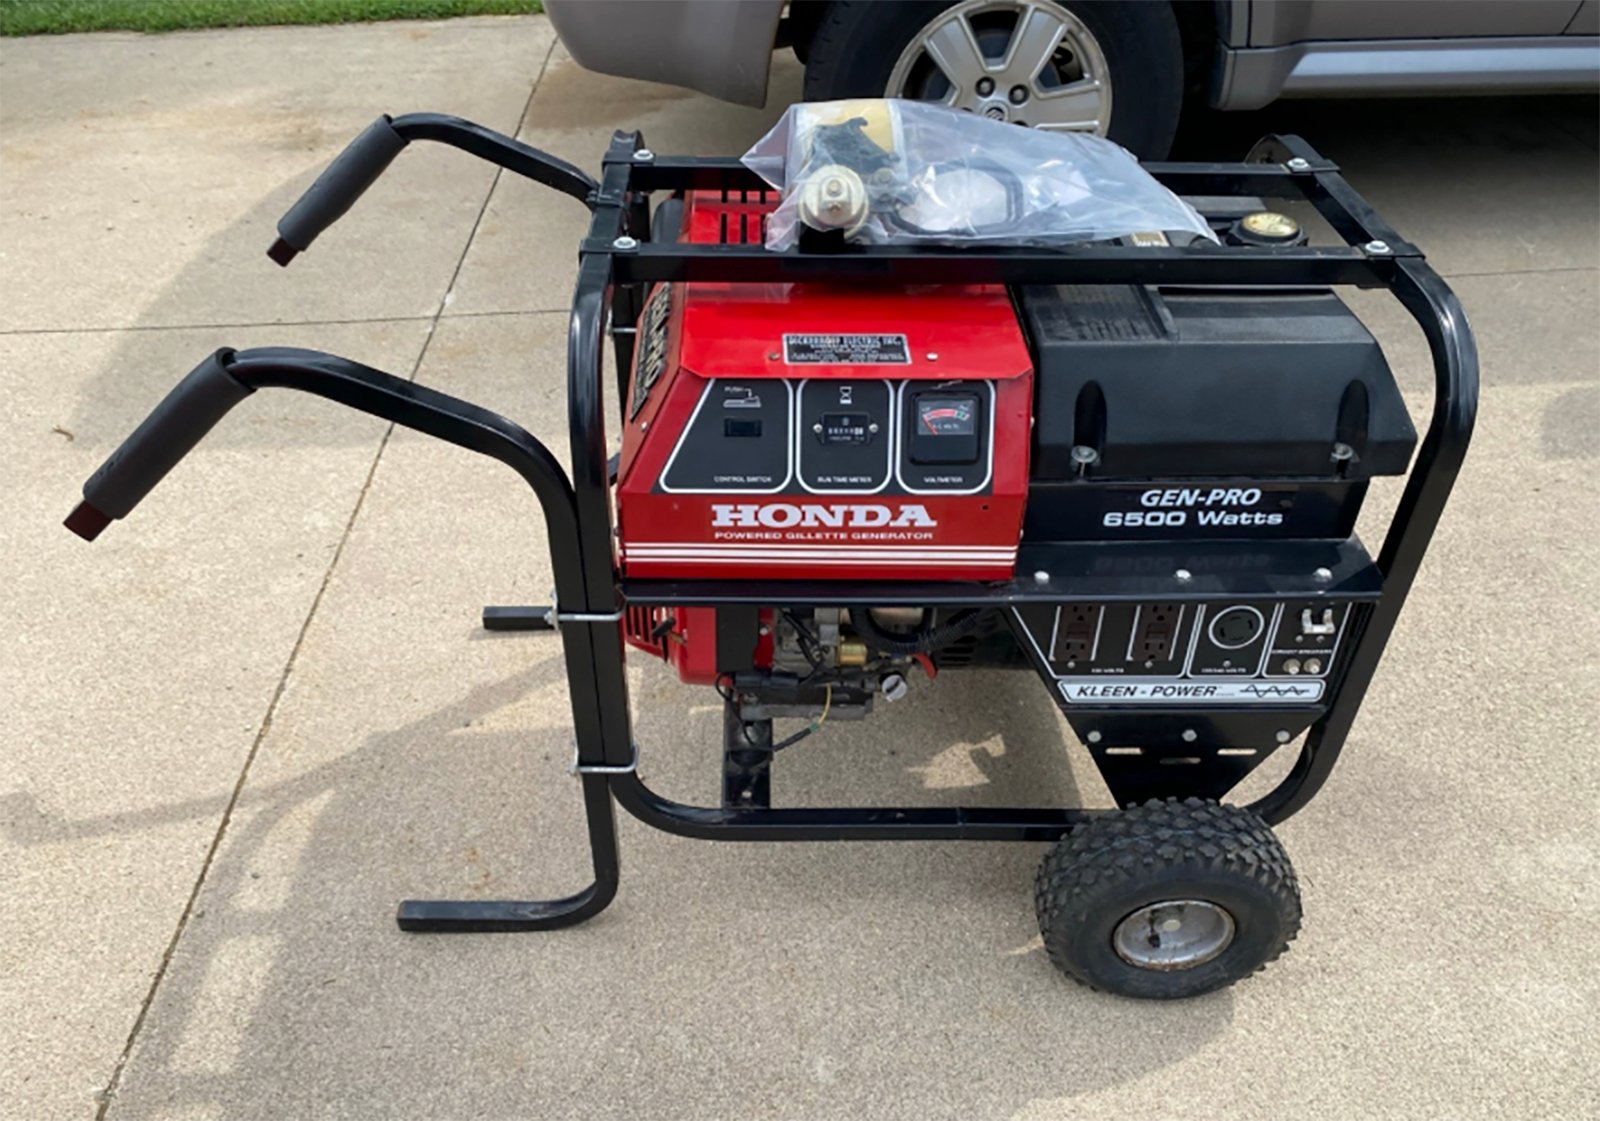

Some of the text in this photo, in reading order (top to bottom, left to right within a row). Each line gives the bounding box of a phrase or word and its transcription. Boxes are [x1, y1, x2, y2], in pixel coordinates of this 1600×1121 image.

[1140, 488, 1262, 507] GEN-PRO
[711, 503, 938, 528] HONDA
[1102, 510, 1284, 527] 6500 Watts
[714, 532, 933, 540] POWERED GILLETTE GENERATOR
[1077, 685, 1138, 697] KLEEN
[1150, 685, 1218, 697] POWER
